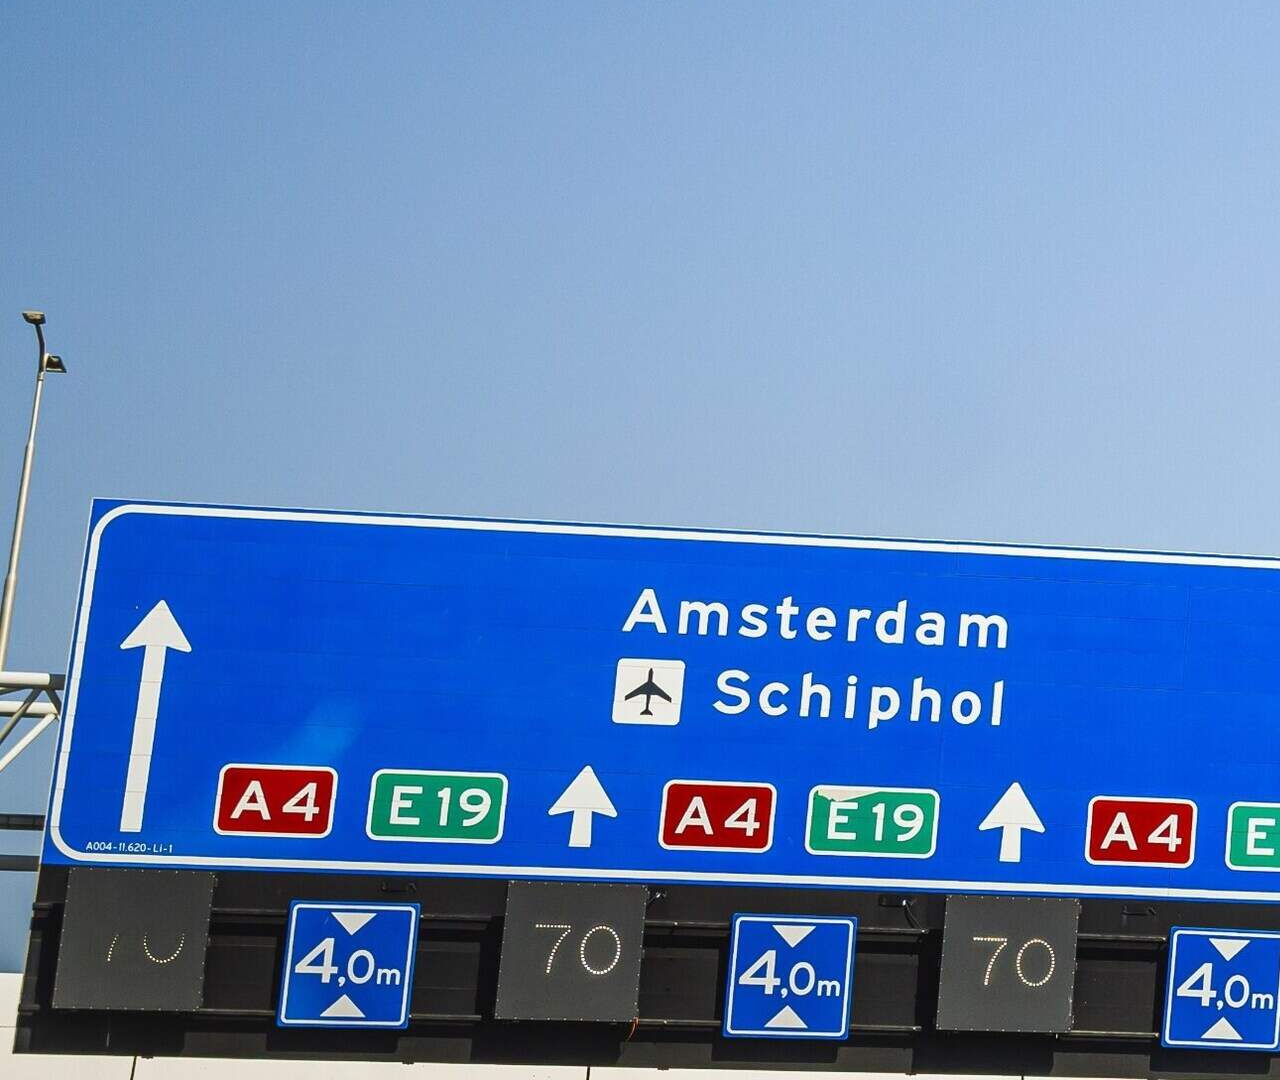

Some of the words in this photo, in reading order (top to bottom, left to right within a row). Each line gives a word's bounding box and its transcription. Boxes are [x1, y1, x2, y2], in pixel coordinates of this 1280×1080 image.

[622, 588, 1009, 649] Amsterdam
[713, 669, 1005, 730] Schiphol
[230, 780, 321, 822] A4
[388, 785, 492, 828] E19
[674, 796, 760, 837] A4
[826, 800, 925, 842] E19
[1100, 812, 1183, 853] A4
[293, 936, 401, 987] 4,0m
[534, 923, 622, 975] 70
[738, 949, 841, 999] 4,0m
[972, 935, 1057, 987] 70
[1176, 961, 1274, 1011] 4,0m
